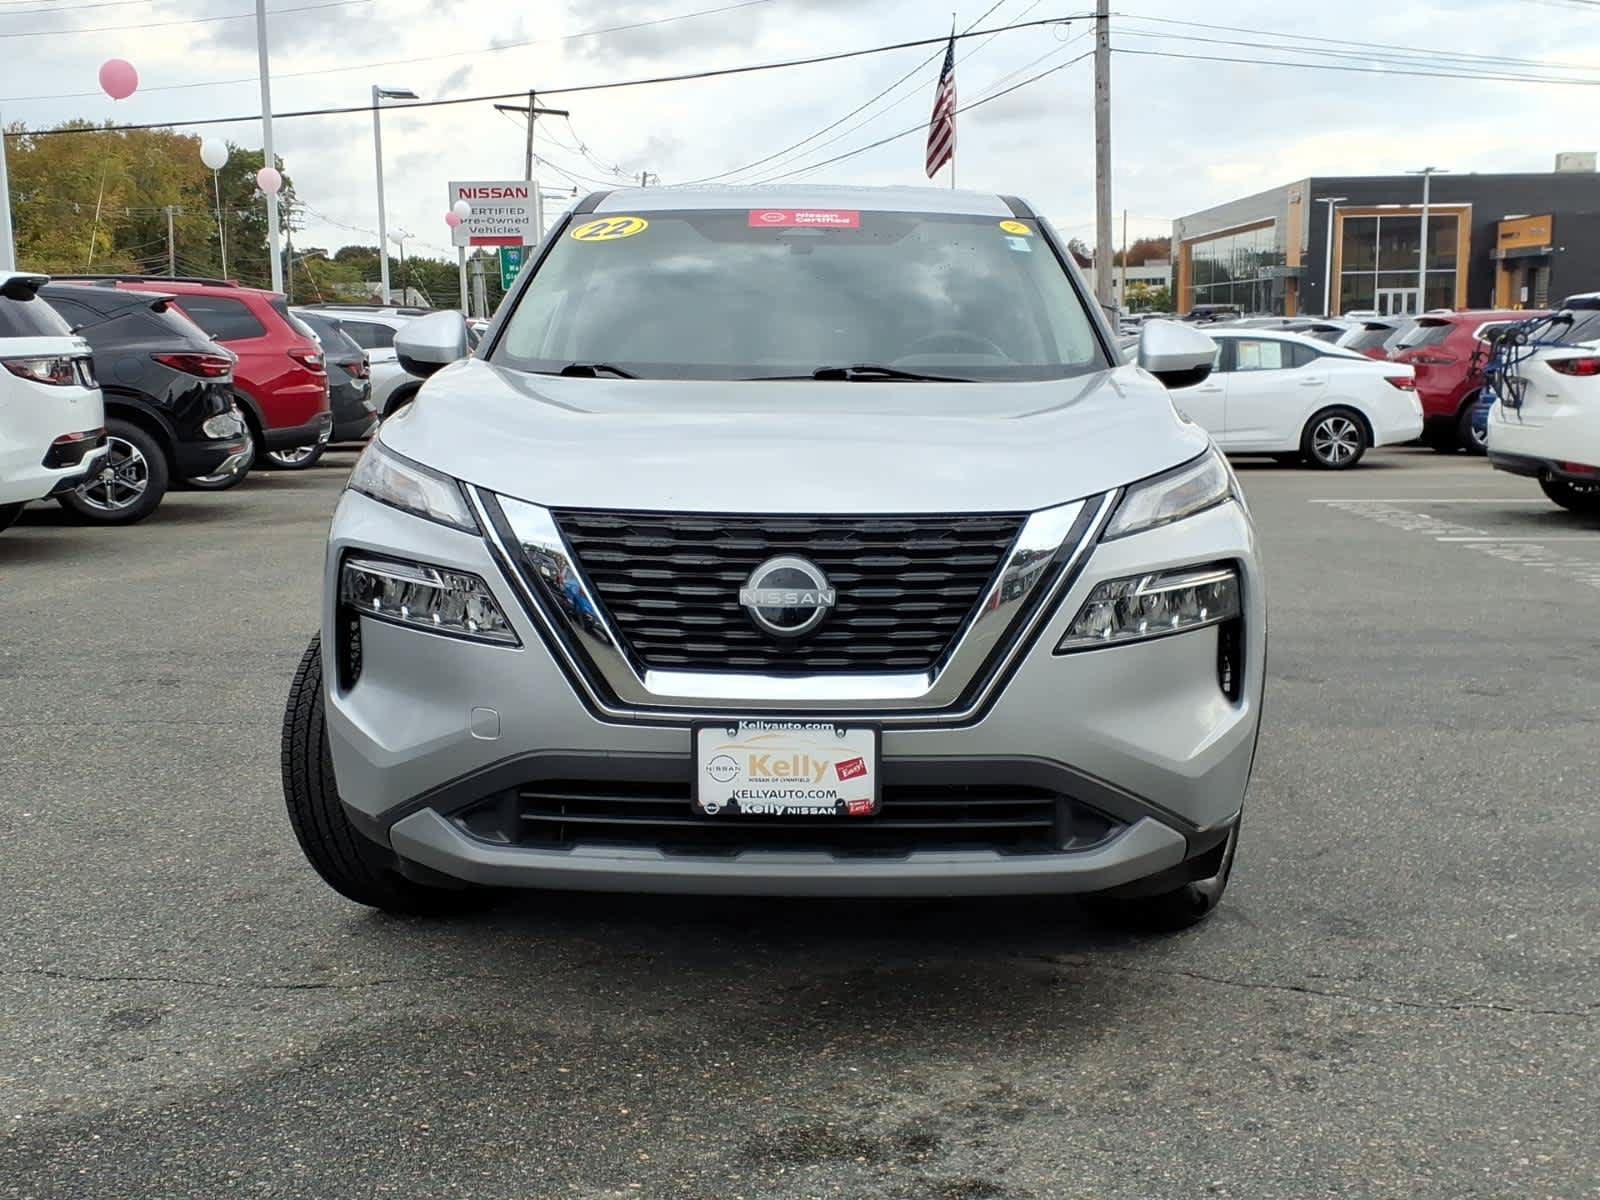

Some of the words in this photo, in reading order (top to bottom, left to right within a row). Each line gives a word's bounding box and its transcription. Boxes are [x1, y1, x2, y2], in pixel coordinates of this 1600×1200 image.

[458, 187, 529, 199] NISSAN
[469, 207, 525, 216] ERTIFIED
[469, 226, 521, 234] Vehicles
[580, 219, 634, 239] 22
[743, 592, 832, 604] NISSAN
[738, 720, 834, 731] Kellyauto.com
[748, 754, 829, 784] Kelly
[733, 790, 837, 799] KELLYAUTO.COM
[741, 803, 787, 815] Kelly
[788, 807, 837, 815] NISSAN
